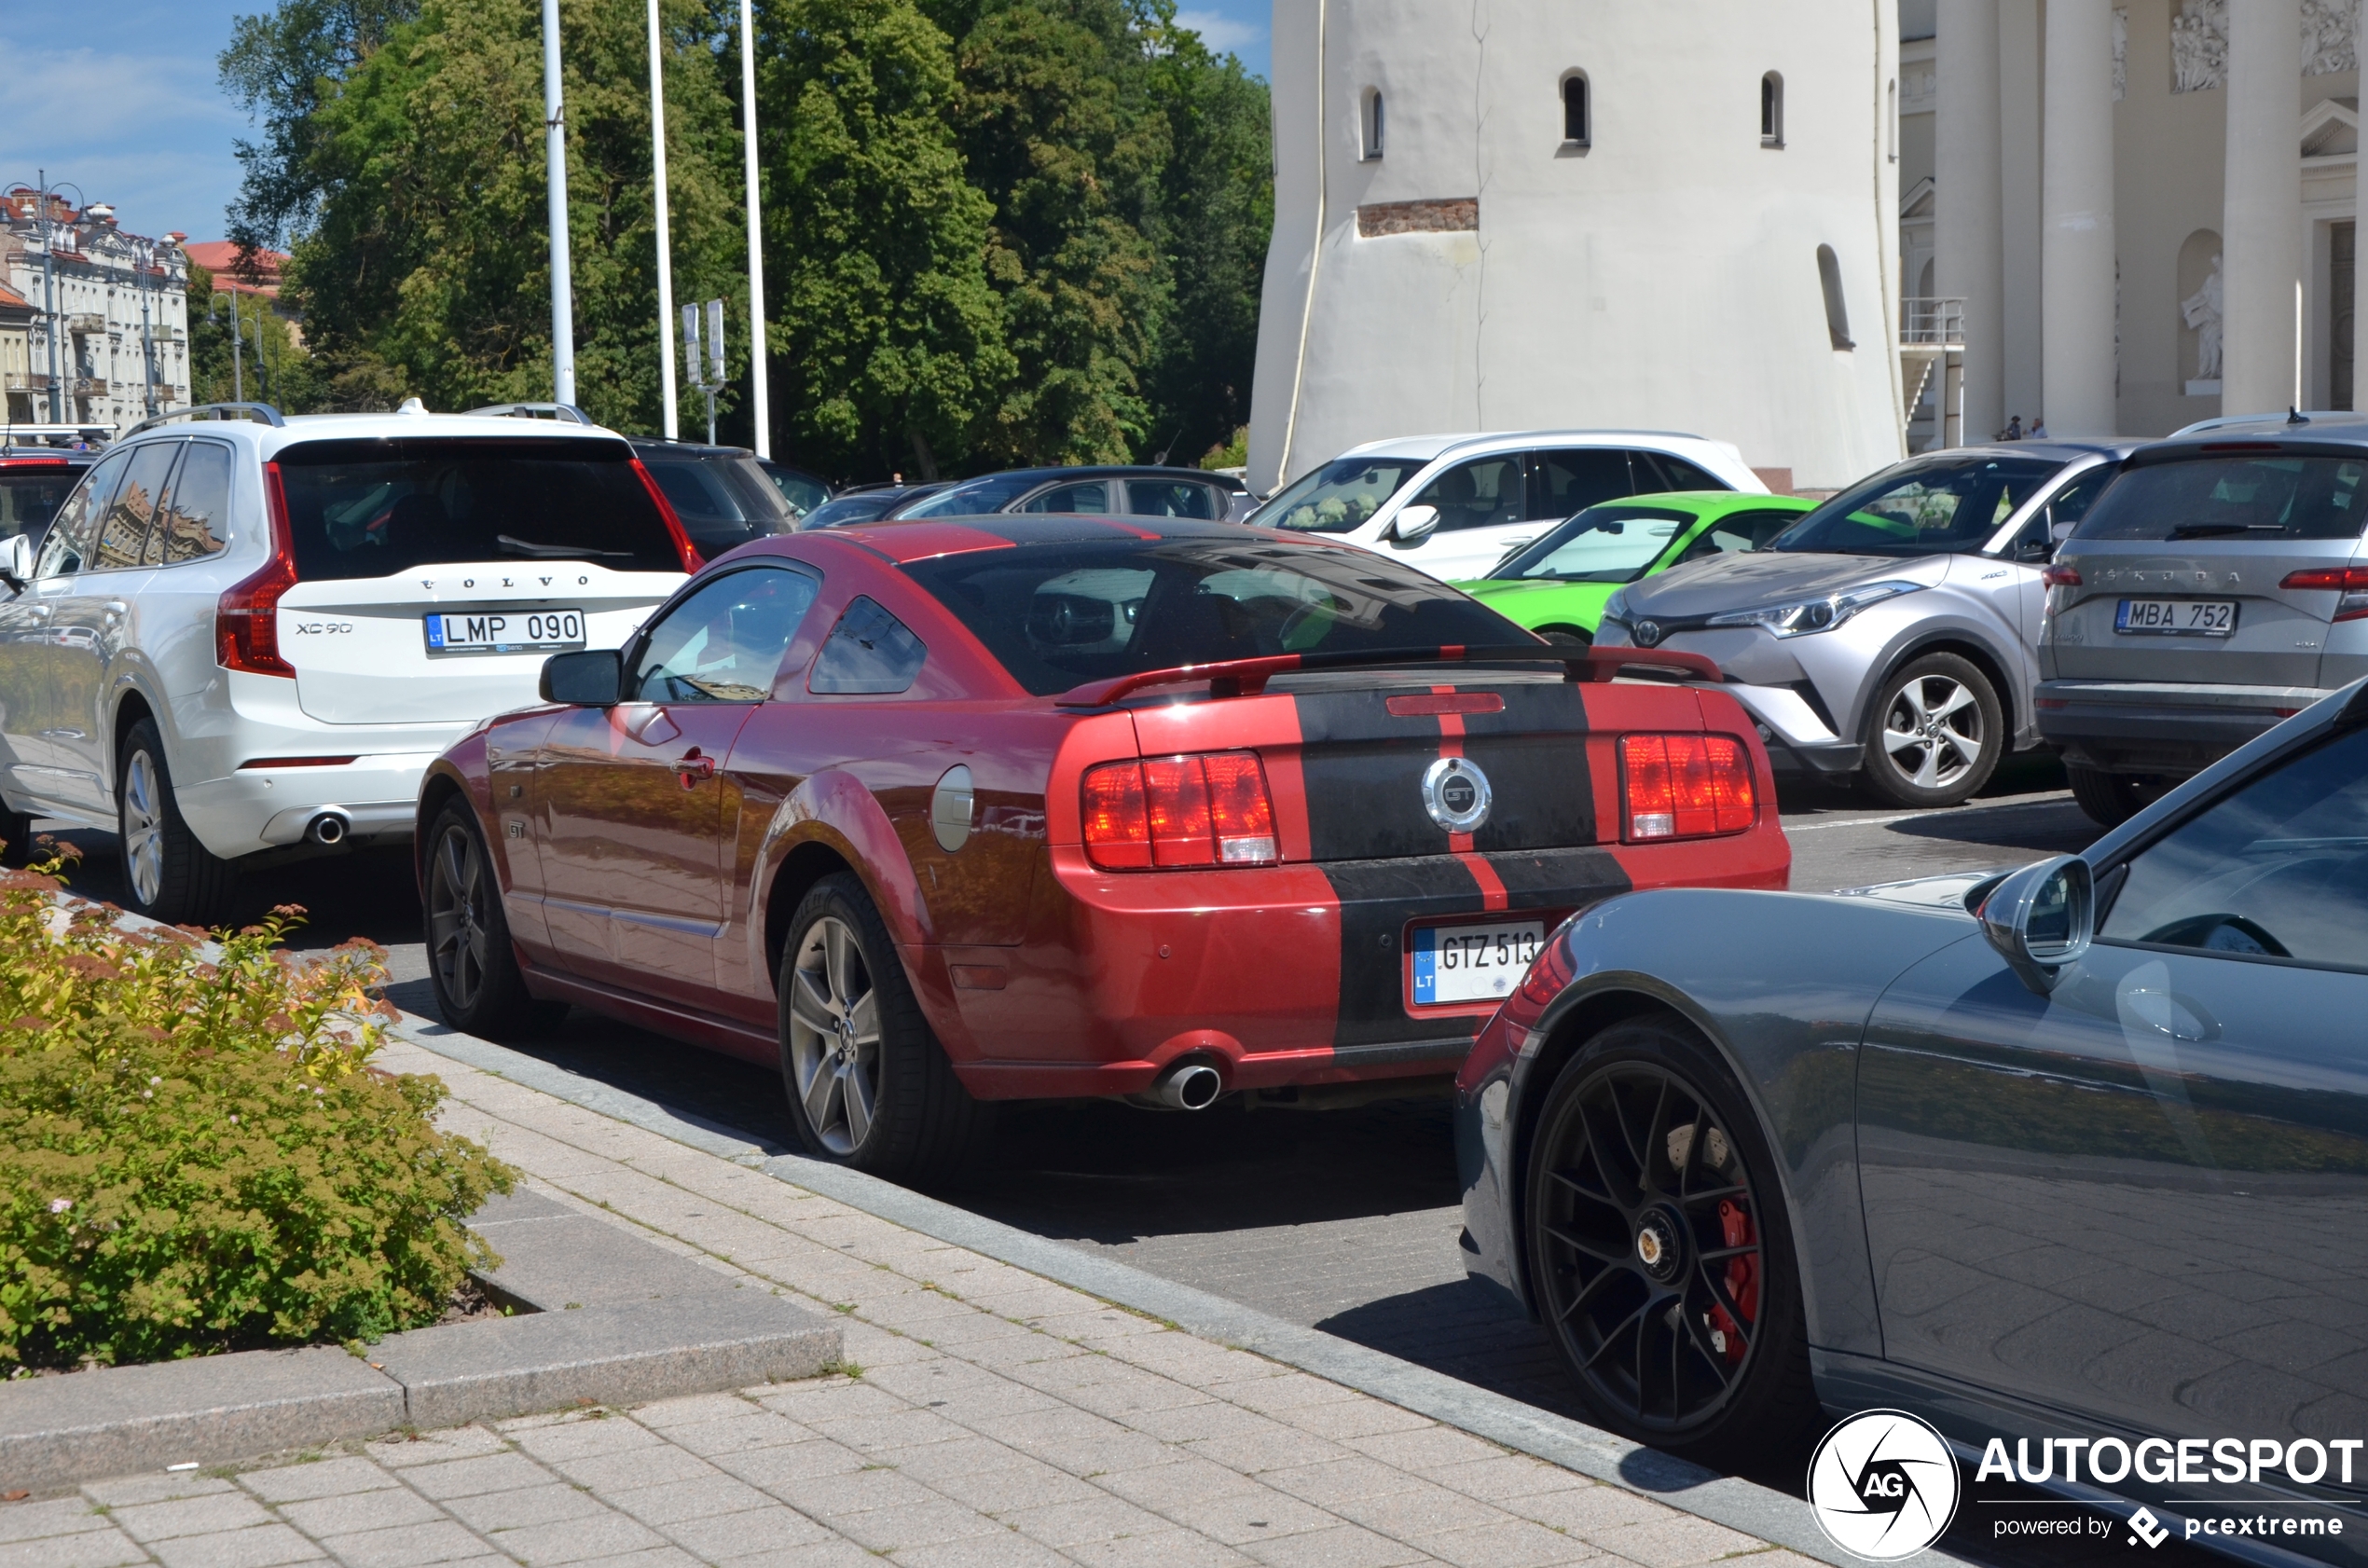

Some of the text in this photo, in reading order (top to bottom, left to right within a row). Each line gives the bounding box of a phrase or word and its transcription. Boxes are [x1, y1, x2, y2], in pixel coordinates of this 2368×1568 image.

[420, 575, 588, 589] VOLVO
[2129, 603, 2230, 628] MBA 752
[445, 613, 579, 643] LMP 090
[430, 634, 442, 642] LT
[1444, 787, 1473, 802] GT
[509, 820, 525, 839] GT
[1443, 931, 1535, 970] GTZ 513
[1416, 975, 1434, 988] LT
